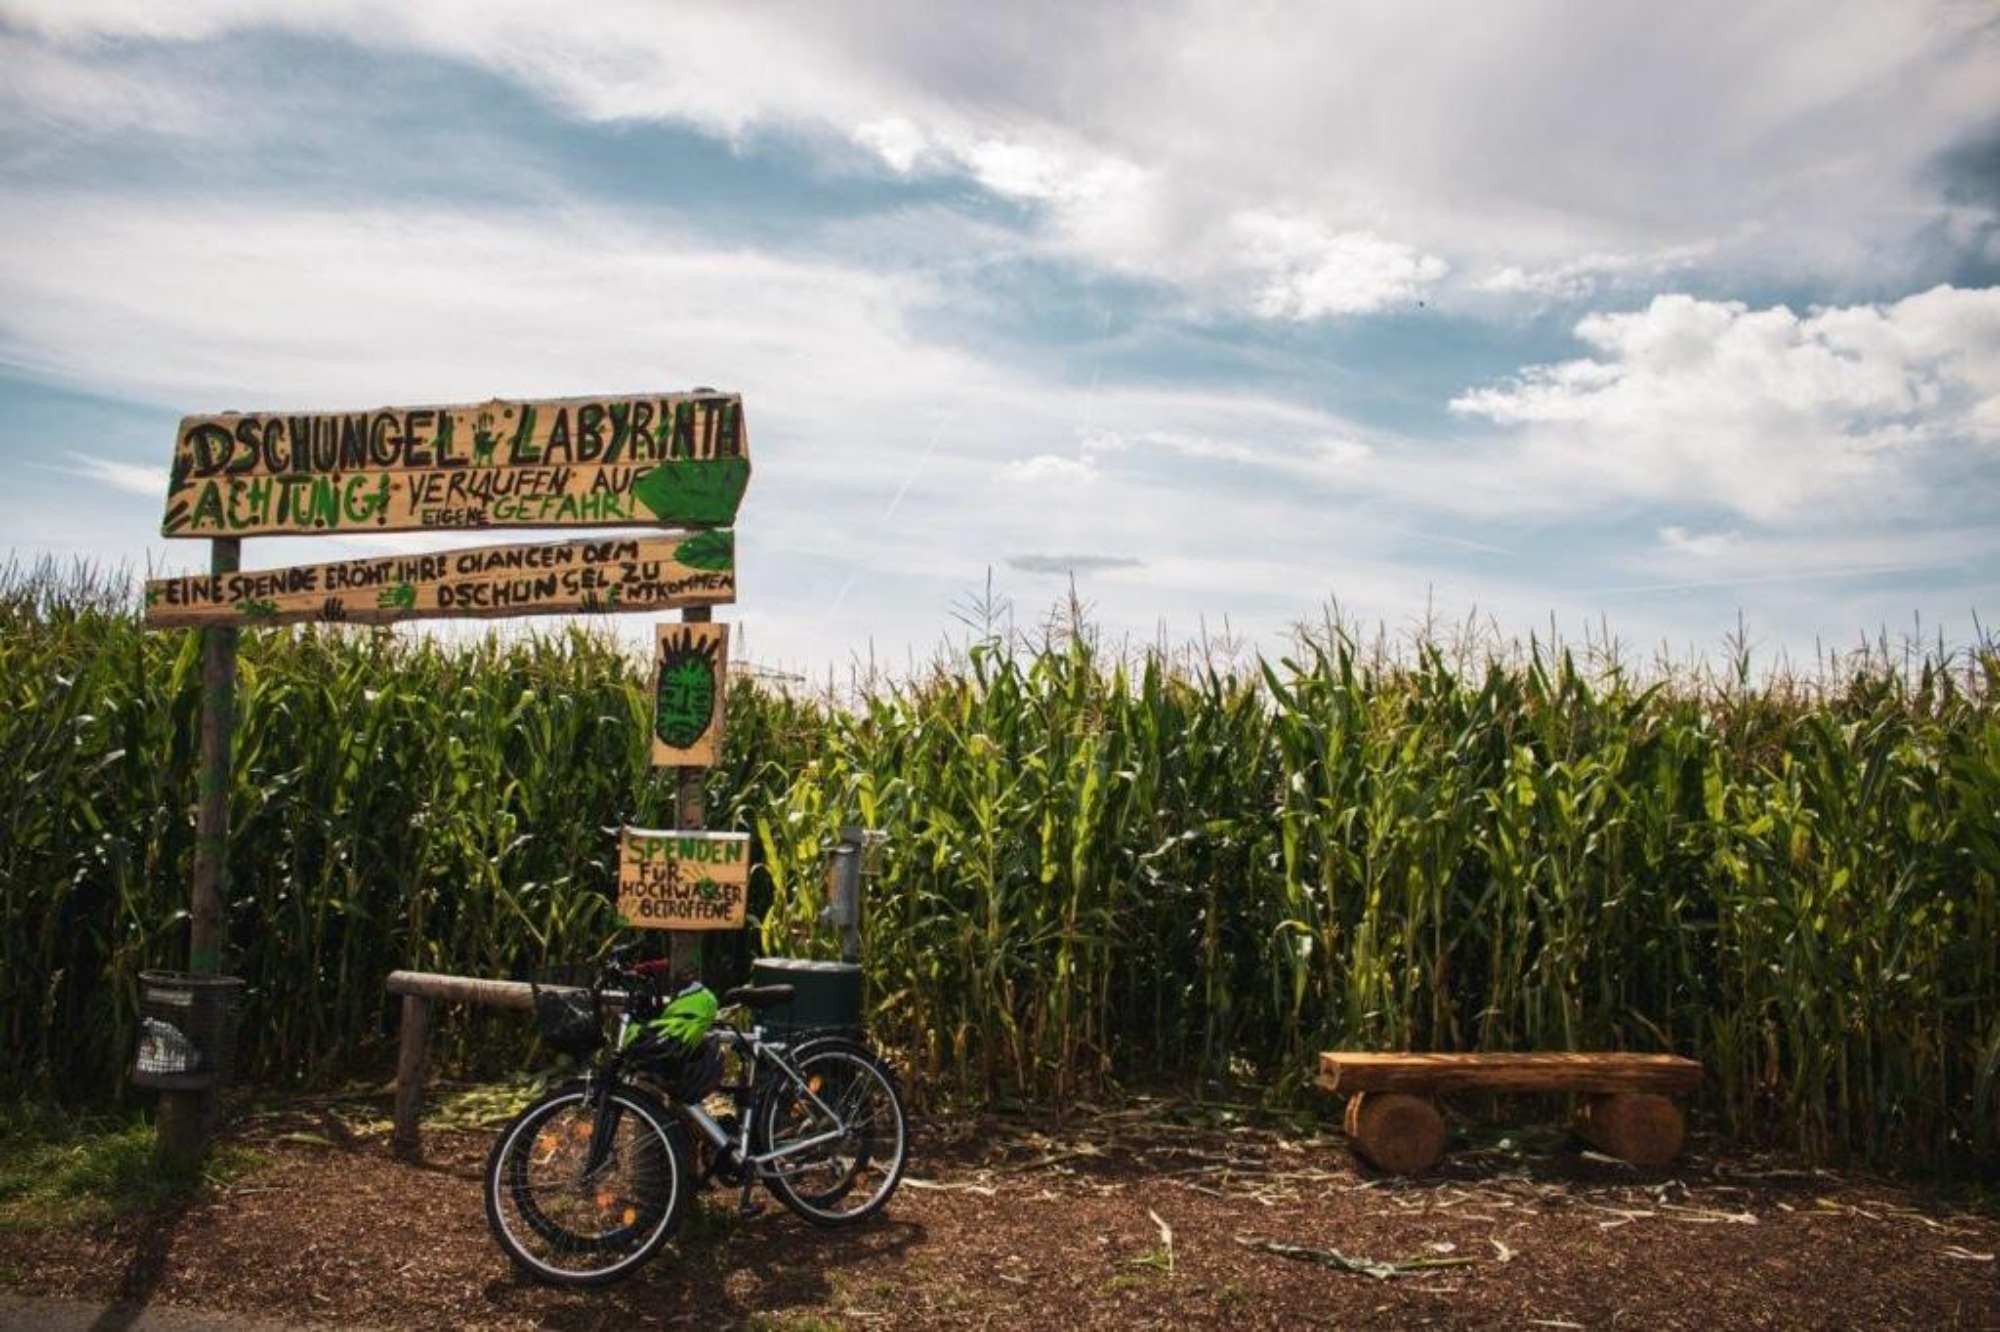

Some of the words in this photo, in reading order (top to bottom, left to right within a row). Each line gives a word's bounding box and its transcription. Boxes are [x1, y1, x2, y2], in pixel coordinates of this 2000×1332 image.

[184, 409, 468, 476] DSCHUNGEL
[508, 398, 743, 466] LABYRINTH
[493, 490, 636, 520] GEFAHR!
[165, 575, 223, 605] EINE
[228, 568, 318, 602] SPENDE
[398, 556, 447, 583] IHRE
[456, 546, 572, 575] CHANCEN
[582, 540, 640, 564] DEM
[437, 570, 609, 606] DSCHUNGEL
[620, 561, 660, 583] ZU
[626, 836, 743, 864] SPENDEN
[622, 881, 742, 903] HOCHWASER
